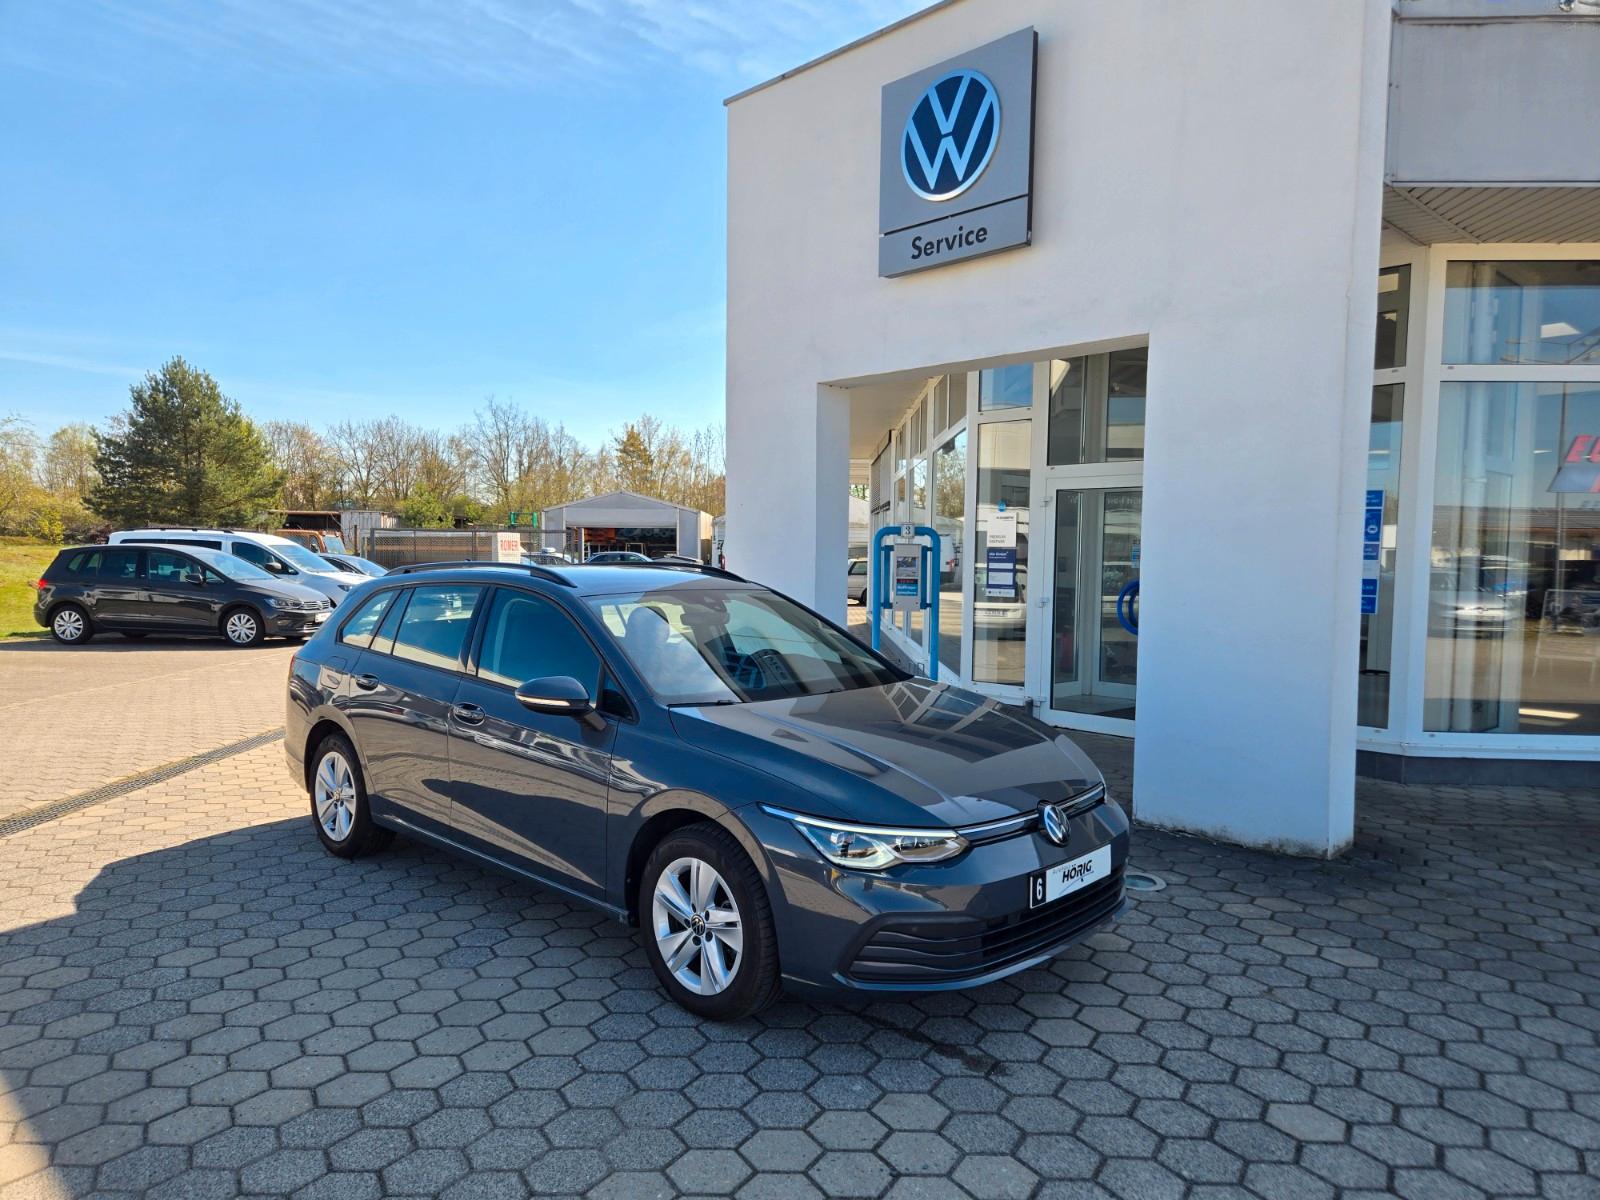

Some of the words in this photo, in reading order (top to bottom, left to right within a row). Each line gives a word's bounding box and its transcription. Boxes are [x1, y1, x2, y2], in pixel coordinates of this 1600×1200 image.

[911, 225, 988, 260] Service
[1062, 859, 1093, 883] HÖRIG
[1036, 878, 1043, 901] 6
